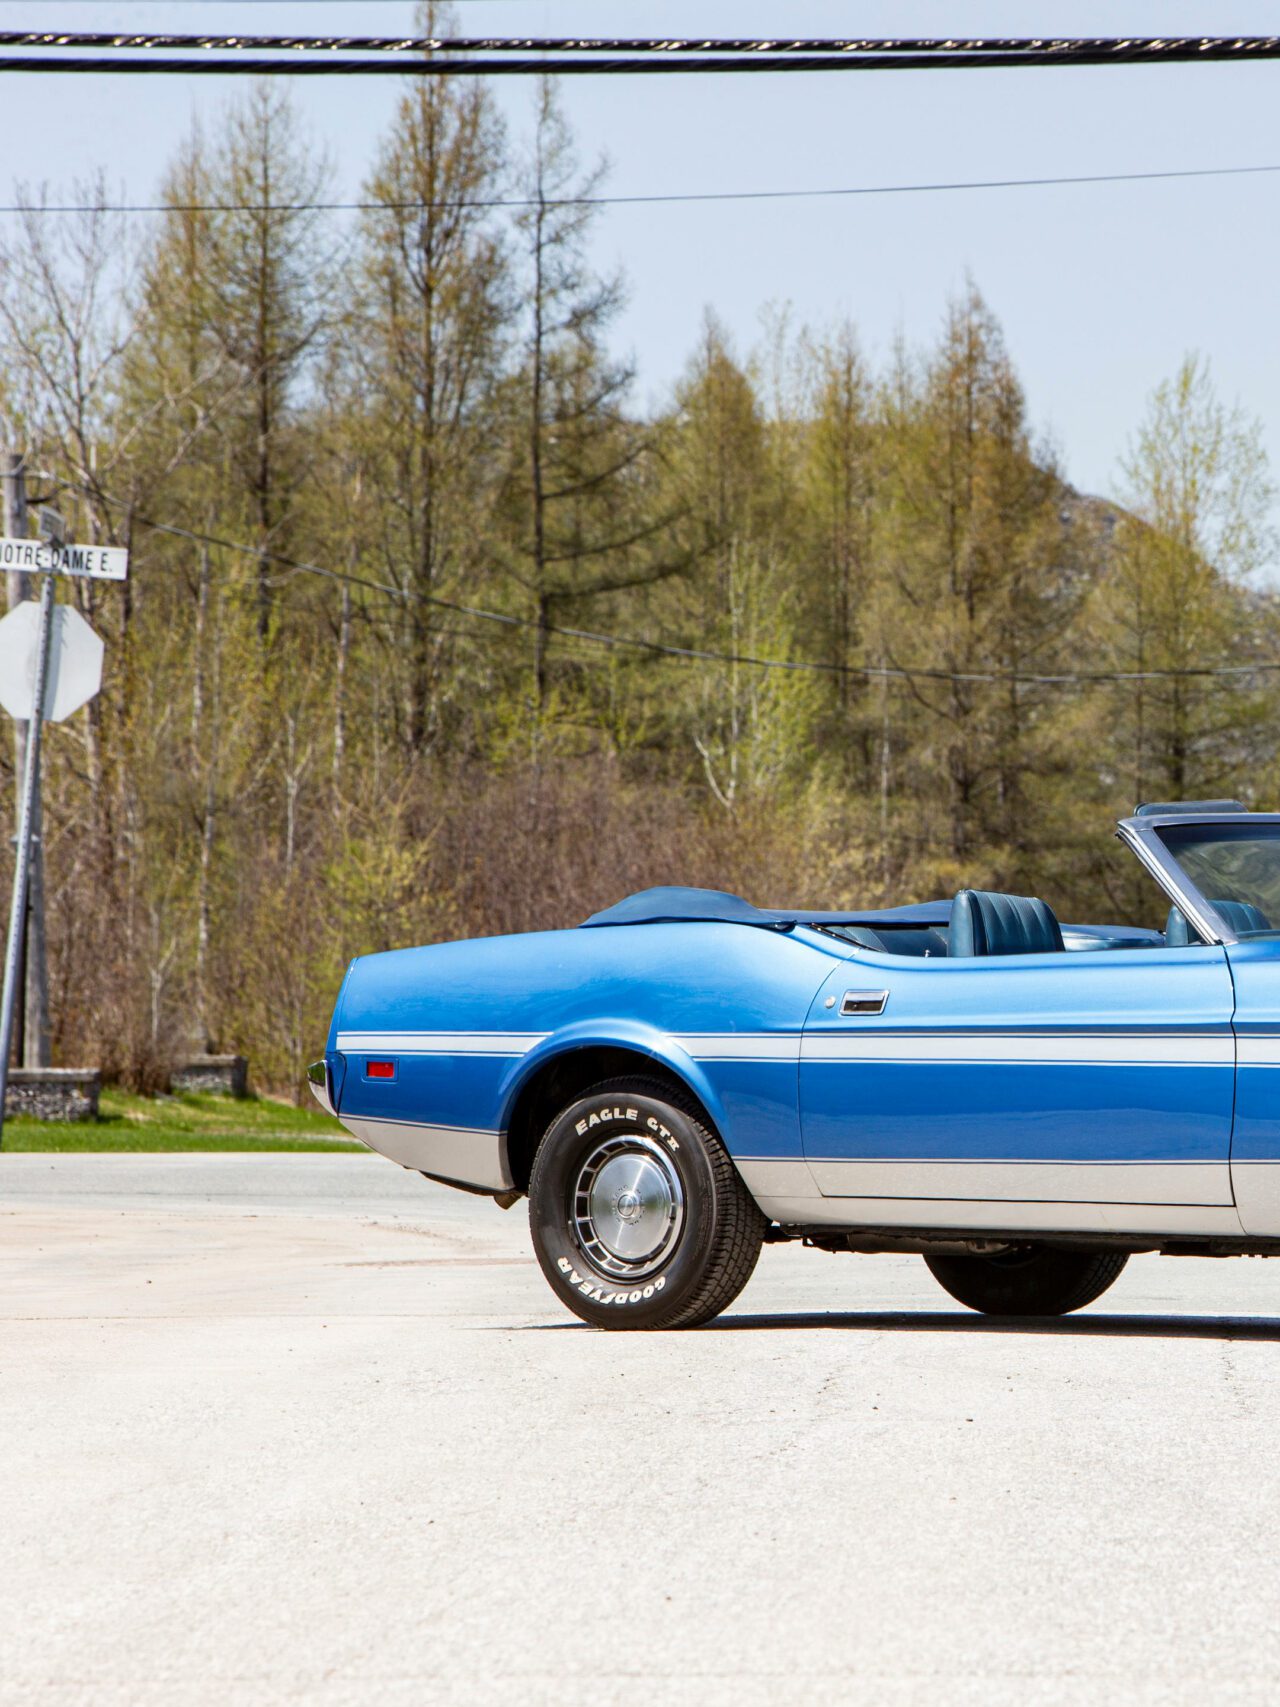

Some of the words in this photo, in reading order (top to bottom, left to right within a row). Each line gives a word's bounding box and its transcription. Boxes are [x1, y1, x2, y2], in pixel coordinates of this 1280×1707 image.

[0, 544, 94, 570] OTRE-DAME
[575, 1107, 639, 1136] EAGLE
[557, 1257, 667, 1305] GOODYEAR
